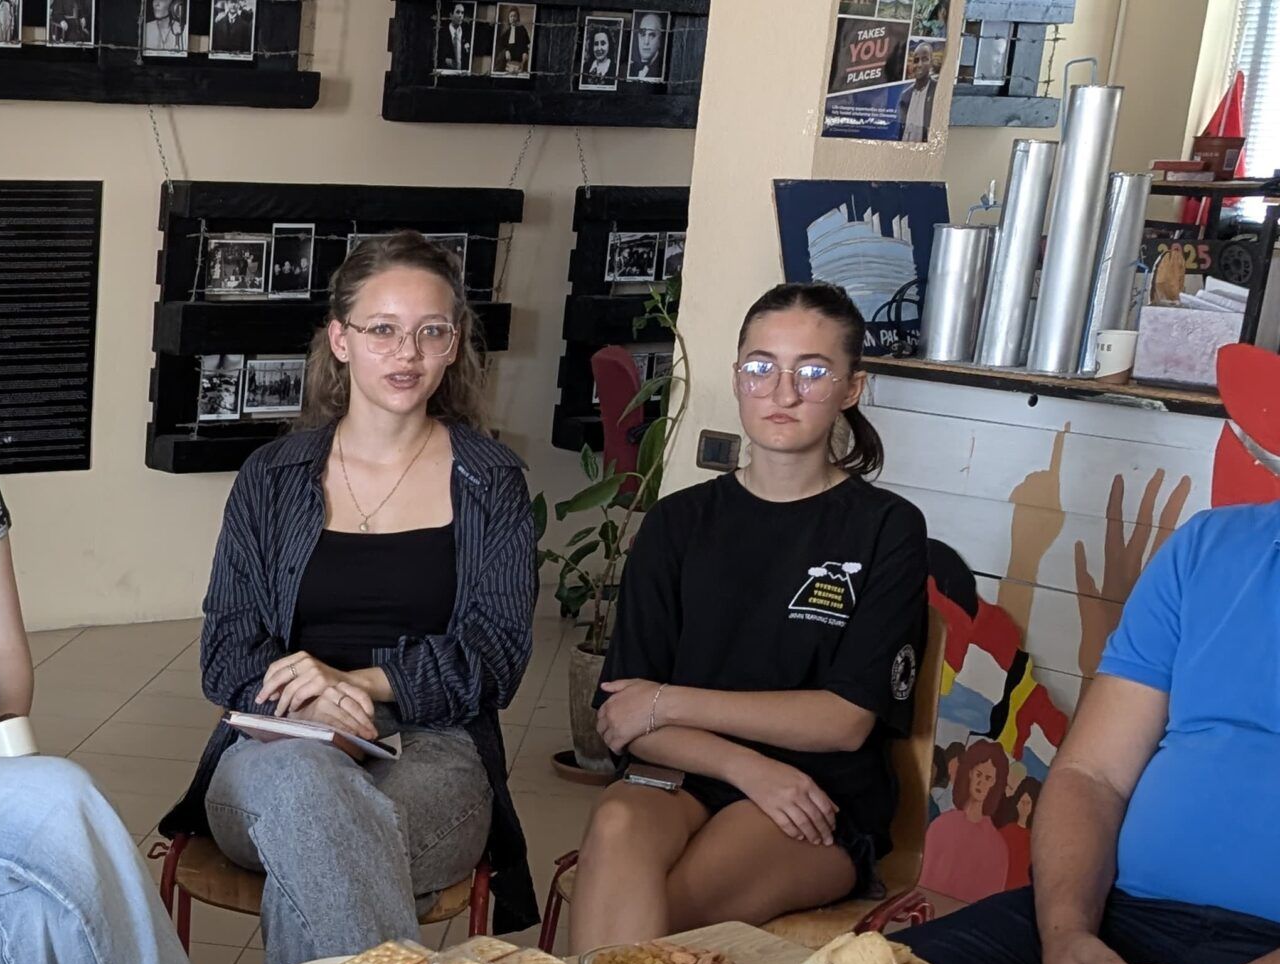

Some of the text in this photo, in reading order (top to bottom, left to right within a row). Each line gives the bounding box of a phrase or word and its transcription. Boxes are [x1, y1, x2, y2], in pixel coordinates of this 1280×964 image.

[857, 27, 885, 40] TAKES
[849, 37, 889, 62] YOU
[846, 68, 882, 83] PLACES
